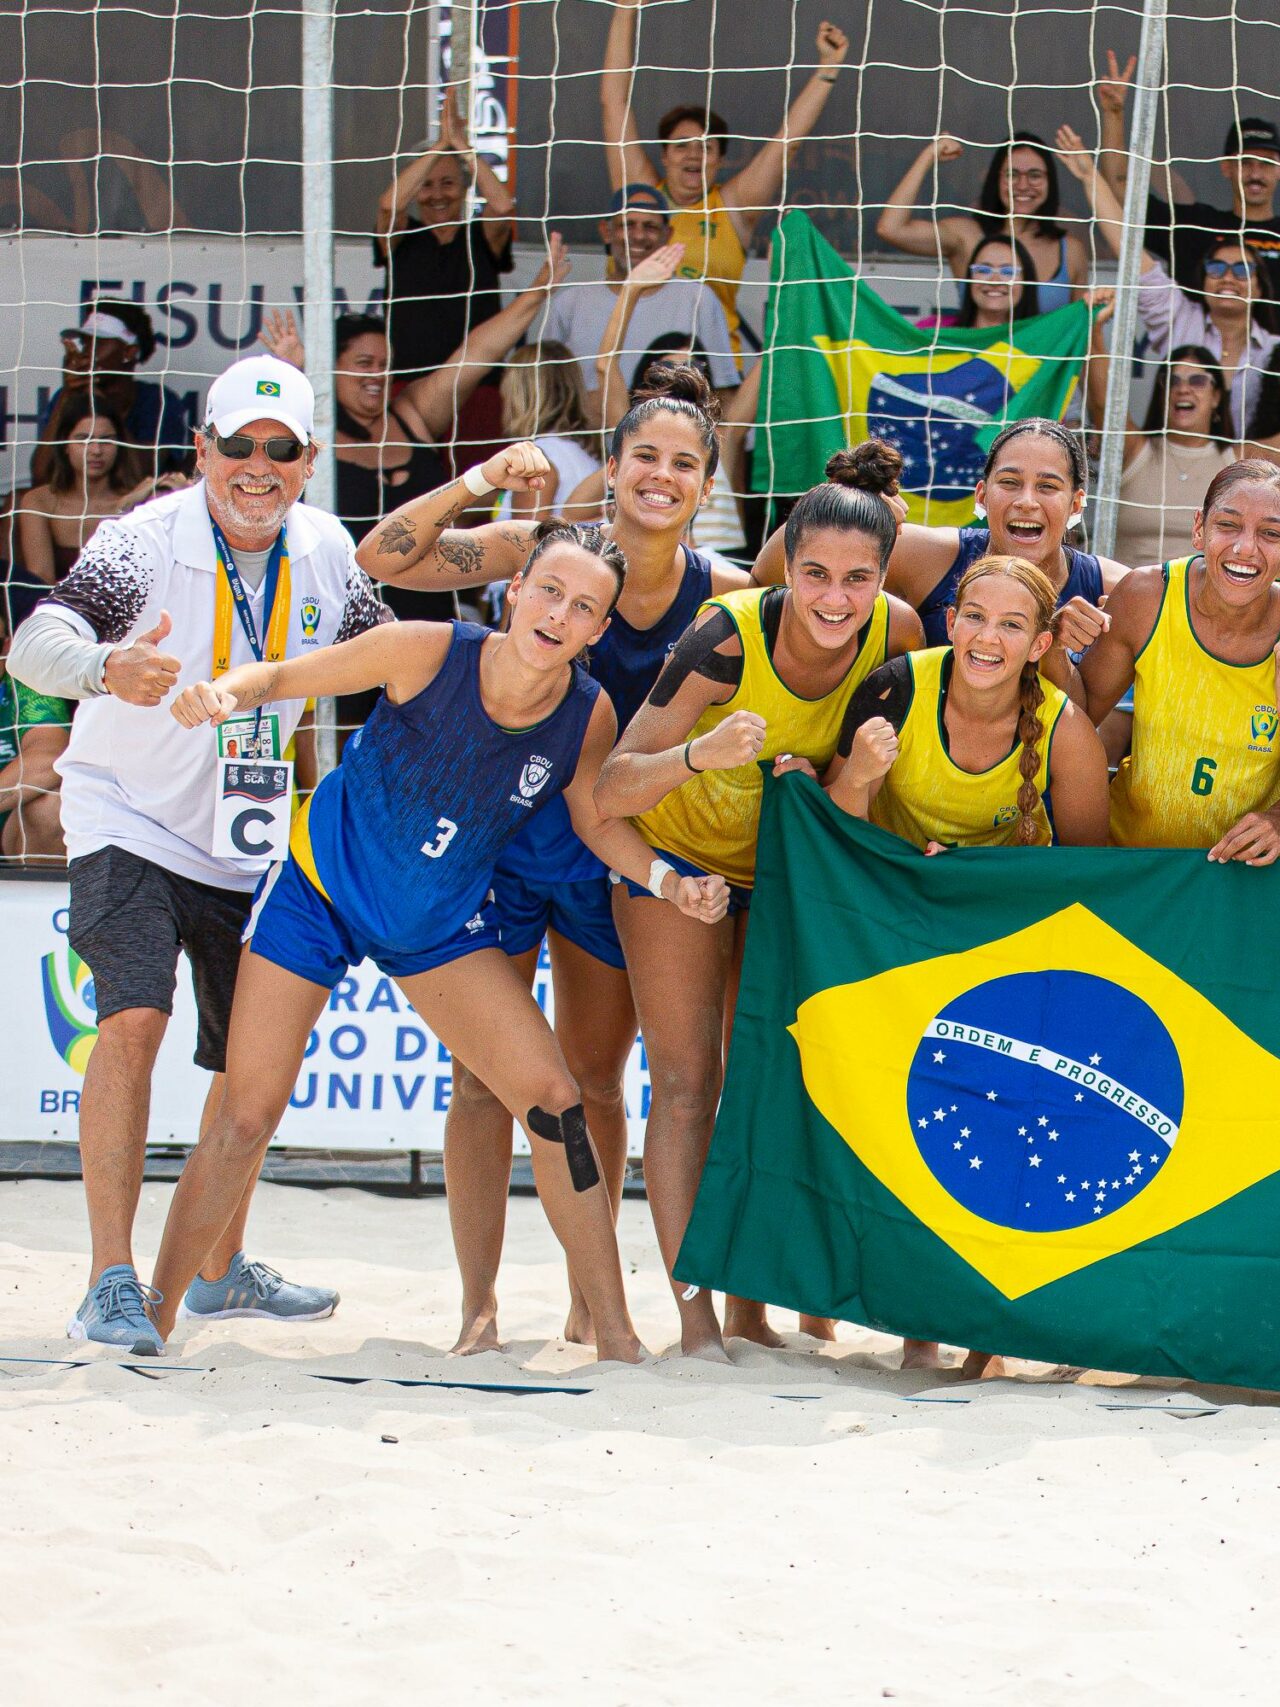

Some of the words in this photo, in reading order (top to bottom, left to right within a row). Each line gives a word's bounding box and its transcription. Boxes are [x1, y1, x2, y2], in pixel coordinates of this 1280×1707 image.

[80, 280, 264, 350] FSU
[302, 597, 320, 605] CBDU
[1254, 705, 1278, 715] CBDU
[1247, 744, 1273, 753] BRASIL
[529, 754, 553, 769] CBDU
[244, 774, 265, 785] SCA
[1190, 756, 1218, 797] 6
[509, 794, 534, 808] BRASIL
[999, 804, 1018, 812] CBD
[230, 808, 276, 856] C
[420, 816, 459, 859] 3
[936, 1022, 1013, 1054] ORDEM
[1029, 1048, 1041, 1062] E
[1054, 1059, 1172, 1136] PROGRESSO
[288, 1073, 452, 1112] UNIVE
